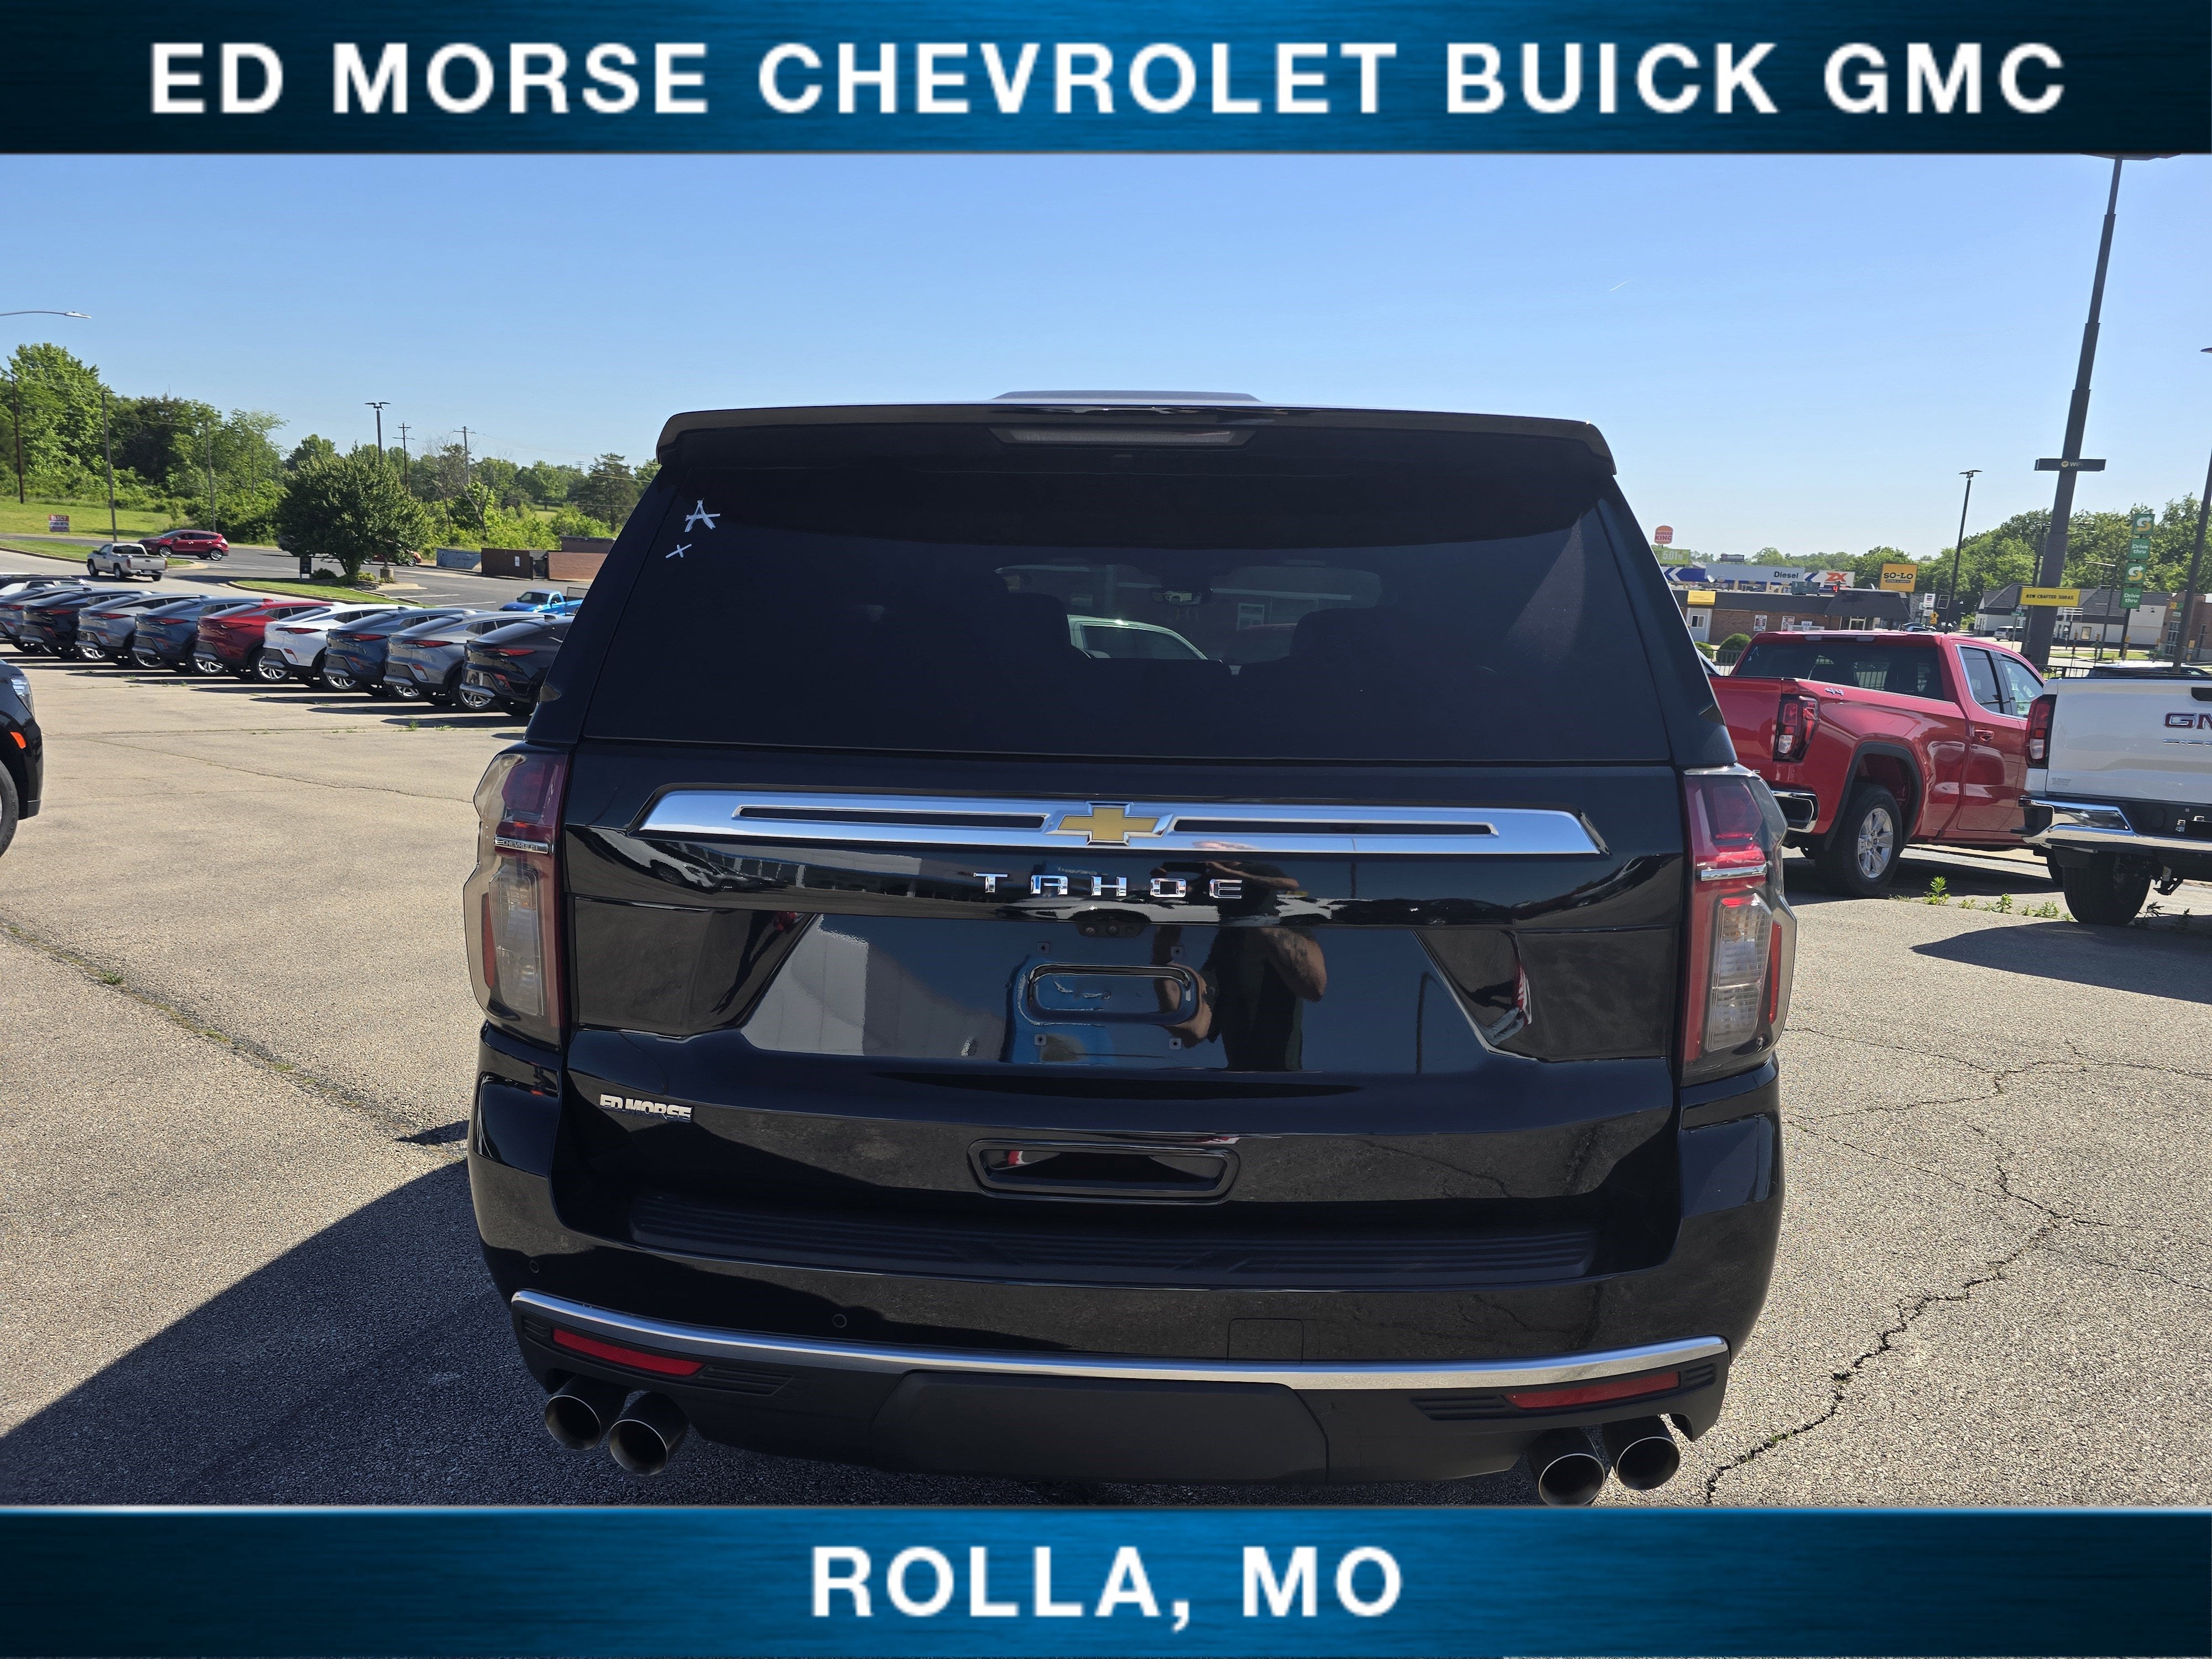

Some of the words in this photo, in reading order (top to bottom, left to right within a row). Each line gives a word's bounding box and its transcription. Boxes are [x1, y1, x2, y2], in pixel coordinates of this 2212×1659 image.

[684, 499, 721, 533] A
[503, 840, 538, 851] CHEVROLET
[973, 872, 1243, 900] TAHOE
[625, 1098, 693, 1122] MORSE
